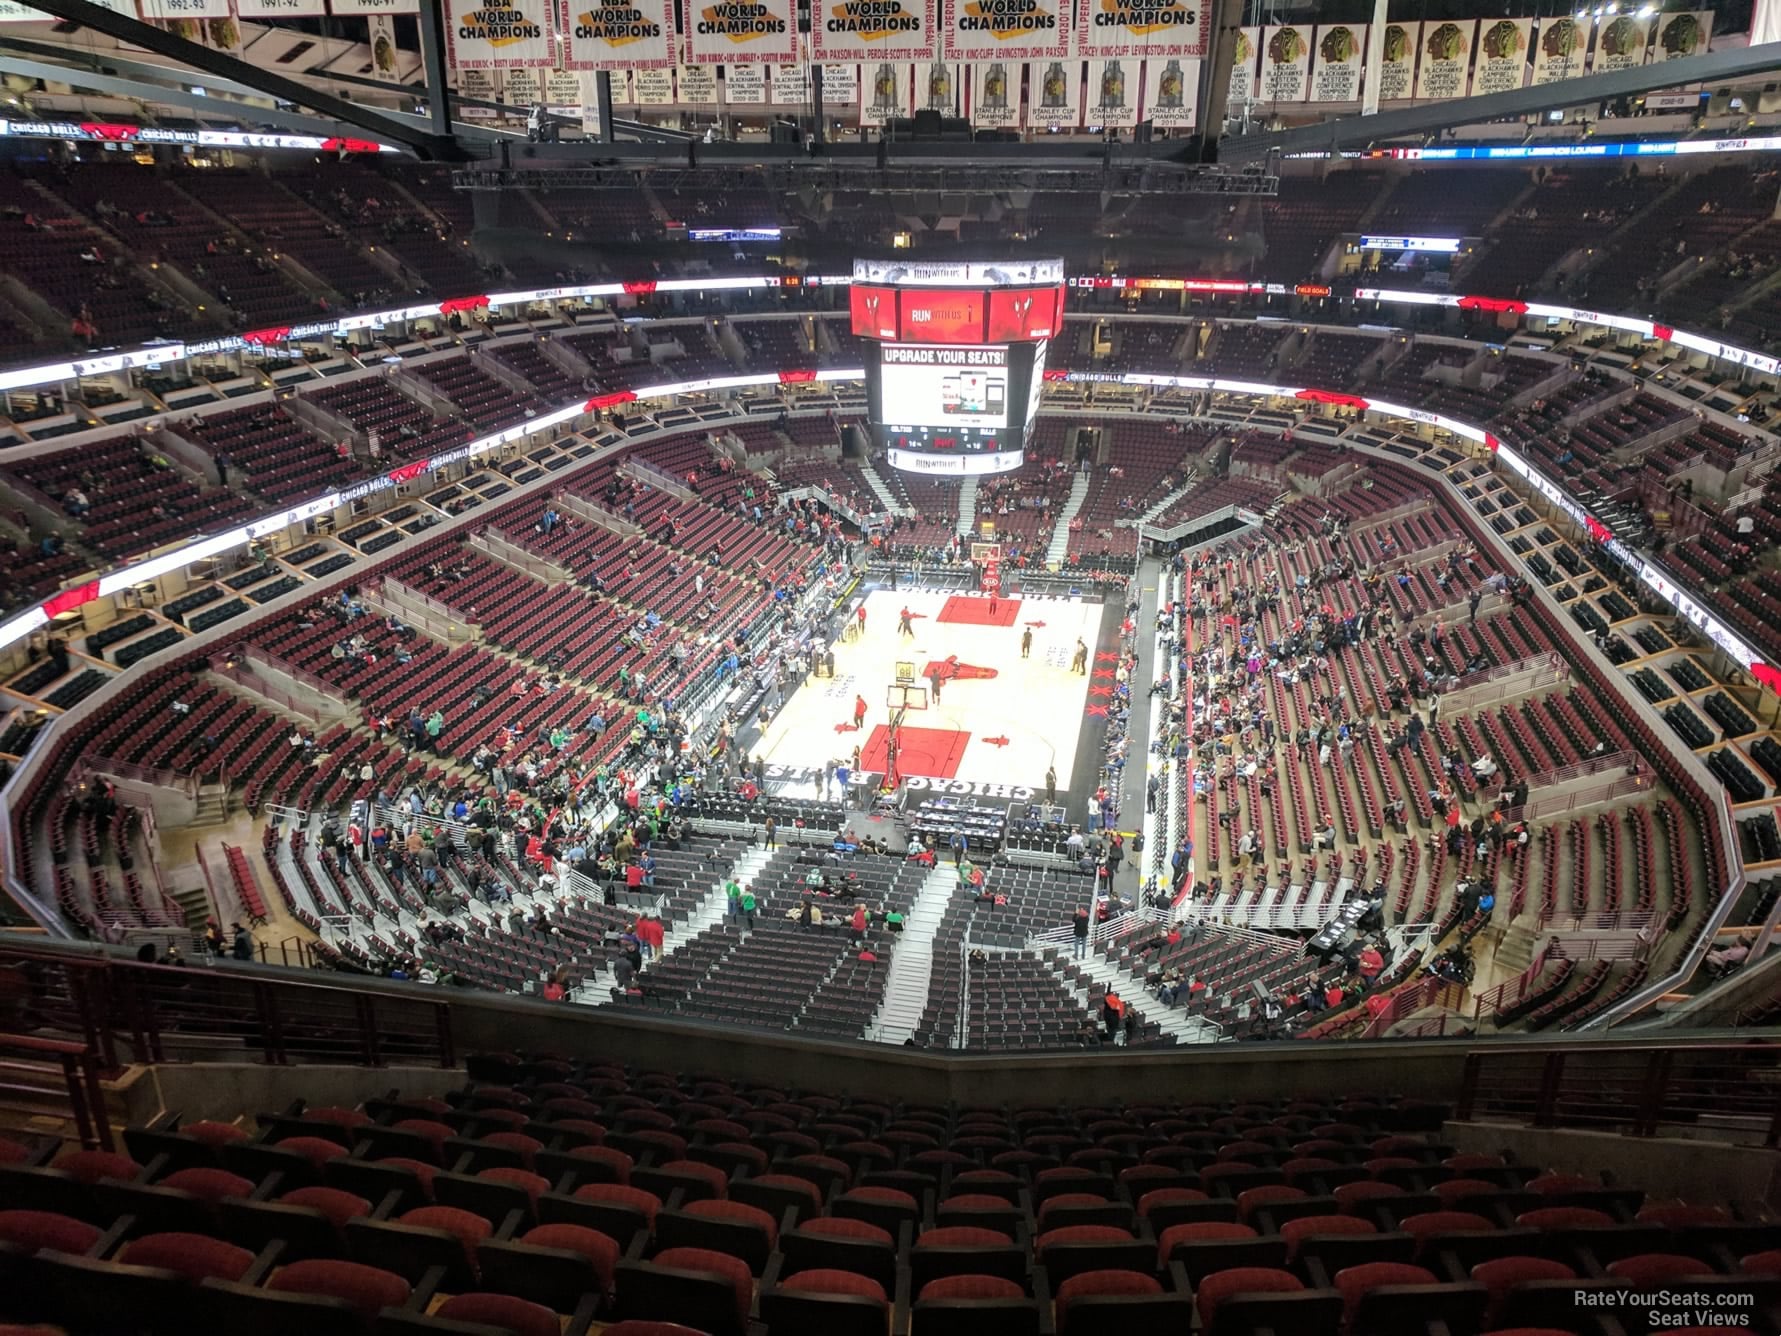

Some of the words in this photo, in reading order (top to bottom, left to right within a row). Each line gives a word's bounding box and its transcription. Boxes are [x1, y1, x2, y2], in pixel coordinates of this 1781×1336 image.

[845, 2, 901, 15] WORLD
[979, 0, 1037, 13] WORLD
[1115, 0, 1176, 9] WORLD
[473, 10, 523, 24] WORLD
[590, 9, 642, 23] WORLD
[713, 5, 768, 20] WORLD
[1094, 11, 1196, 26] CHAMPIONS
[697, 20, 786, 34] CHAMPIONS
[827, 17, 920, 32] CHAMPIONS
[958, 15, 1056, 30] CHAMPIONS
[1059, 12, 1070, 46] JORDAN
[459, 26, 541, 39] CHAMPIONS
[575, 24, 660, 39] CHAMPIONS
[925, 25, 935, 47] NEALY
[944, 28, 955, 48] WILL
[1078, 25, 1089, 44] WILL
[814, 49, 828, 60] JOHN
[913, 48, 934, 59] PIPPEN
[944, 49, 964, 60] STACEY
[1045, 46, 1068, 58] PAXSON
[1078, 46, 1098, 57] STACEY
[1480, 64, 1520, 72] BLACKHAWKS
[1427, 72, 1457, 80] CAMPBELL
[976, 113, 1013, 121] CHAMPIONS
[10, 122, 49, 134] CHICAGO
[51, 124, 80, 136] BULLS
[141, 128, 174, 140] CHICAGO
[175, 129, 198, 141] BULLS
[912, 309, 931, 323] RUN
[292, 324, 319, 336] CHICAGO
[320, 321, 338, 333] BULLS
[186, 340, 219, 354] CHICAGO
[219, 337, 242, 349] BULLS
[884, 349, 935, 363] UPGRADE
[936, 350, 966, 363] YOUR
[967, 351, 1004, 364] SEATS!
[1070, 373, 1099, 381] CHICAGO
[1100, 373, 1121, 381] BULLS
[341, 483, 369, 502] CHICAGO
[369, 477, 388, 491] BULLS
[907, 776, 1034, 799] CHICAG
